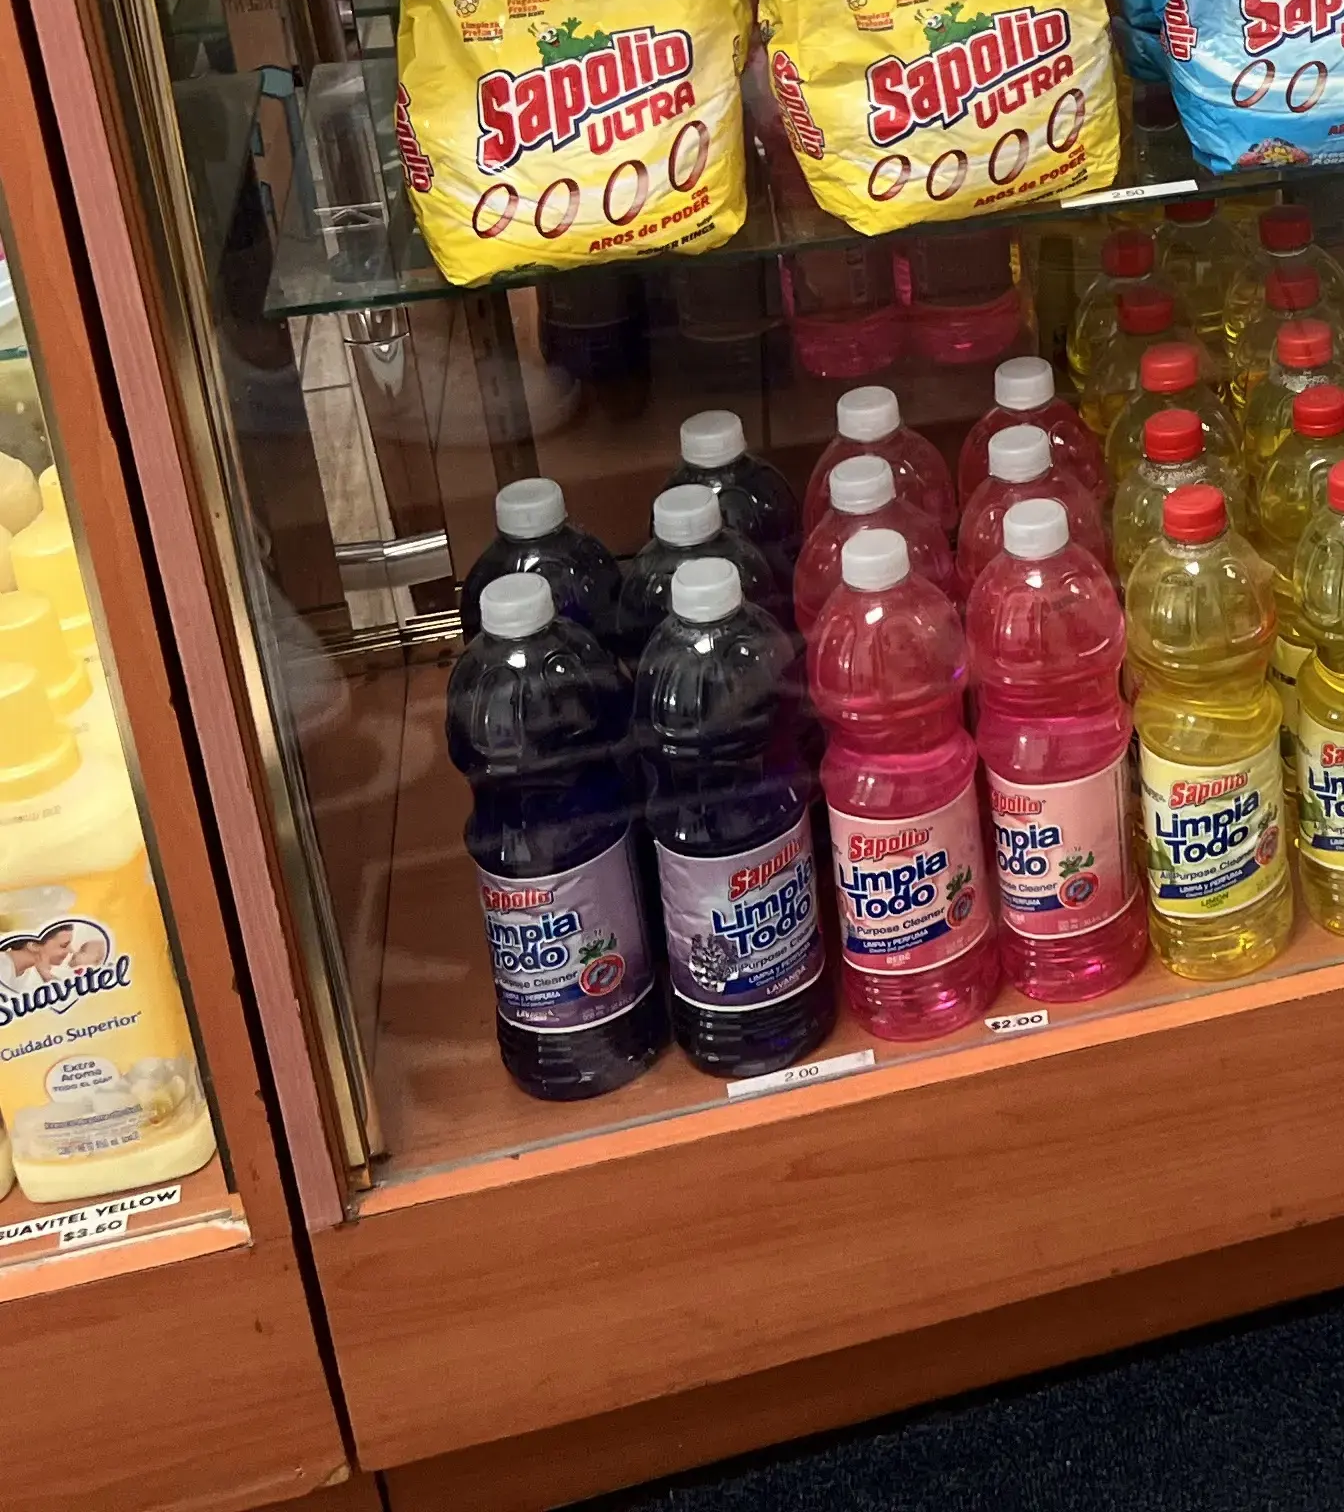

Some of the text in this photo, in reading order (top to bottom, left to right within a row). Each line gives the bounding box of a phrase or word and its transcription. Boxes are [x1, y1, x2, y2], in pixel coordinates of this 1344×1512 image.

[866, 6, 1071, 148] Sapolio
[973, 54, 1074, 130] ULTRA
[477, 26, 693, 176] Sapolio
[587, 82, 696, 156] ULTRA
[692, 186, 709, 200] con
[973, 154, 1087, 208] AROS de PODER
[1111, 188, 1145, 199] 2.50
[589, 230, 634, 253] AROS
[661, 194, 711, 228] PODER
[1169, 771, 1249, 809] Sapolio
[1155, 790, 1261, 838] Limpia
[848, 826, 931, 863] Sapolio
[1165, 824, 1250, 865] Todo
[839, 848, 948, 891] Limpia
[482, 885, 554, 914] Sapolio
[711, 854, 813, 933] Limpia
[851, 881, 938, 921] Todo
[725, 892, 811, 958] Todo
[857, 906, 945, 937] Purpose Cleaner
[0, 955, 130, 1026] Suavitel
[534, 971, 578, 988] Cleaner
[1, 1011, 138, 1062] Cuidado Superior
[991, 1013, 1043, 1031] $2.00
[61, 1069, 102, 1083] Aroma
[63, 1060, 95, 1074] Extra
[785, 1065, 819, 1082] 2.00
[95, 1189, 179, 1217] YELLOW
[63, 1219, 122, 1243] $3.50
